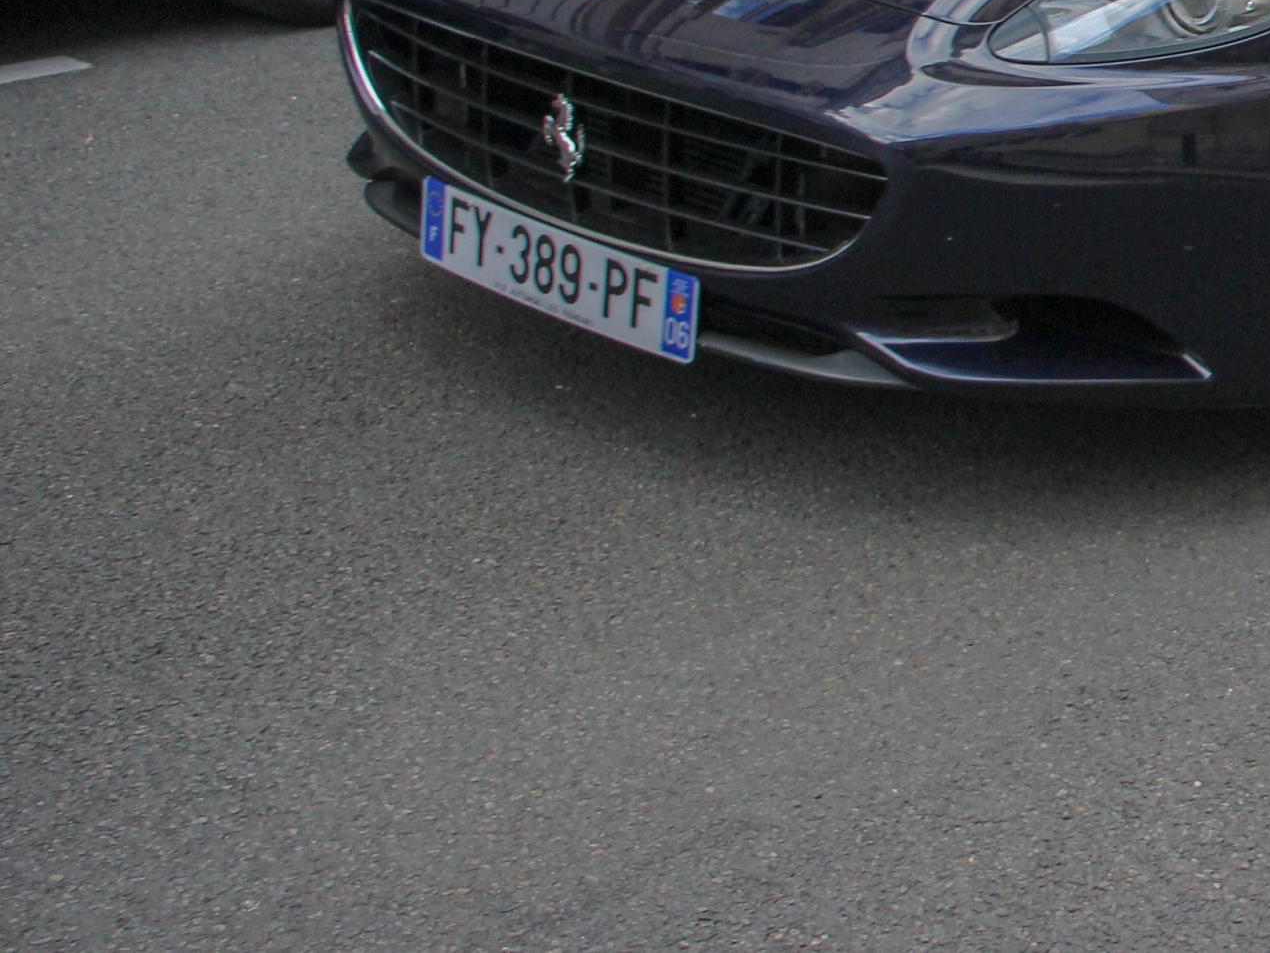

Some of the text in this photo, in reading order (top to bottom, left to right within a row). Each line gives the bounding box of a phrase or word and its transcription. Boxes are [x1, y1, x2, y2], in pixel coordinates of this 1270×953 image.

[429, 225, 439, 242] F
[450, 197, 658, 329] FY-389-PF
[664, 317, 690, 350] 06
